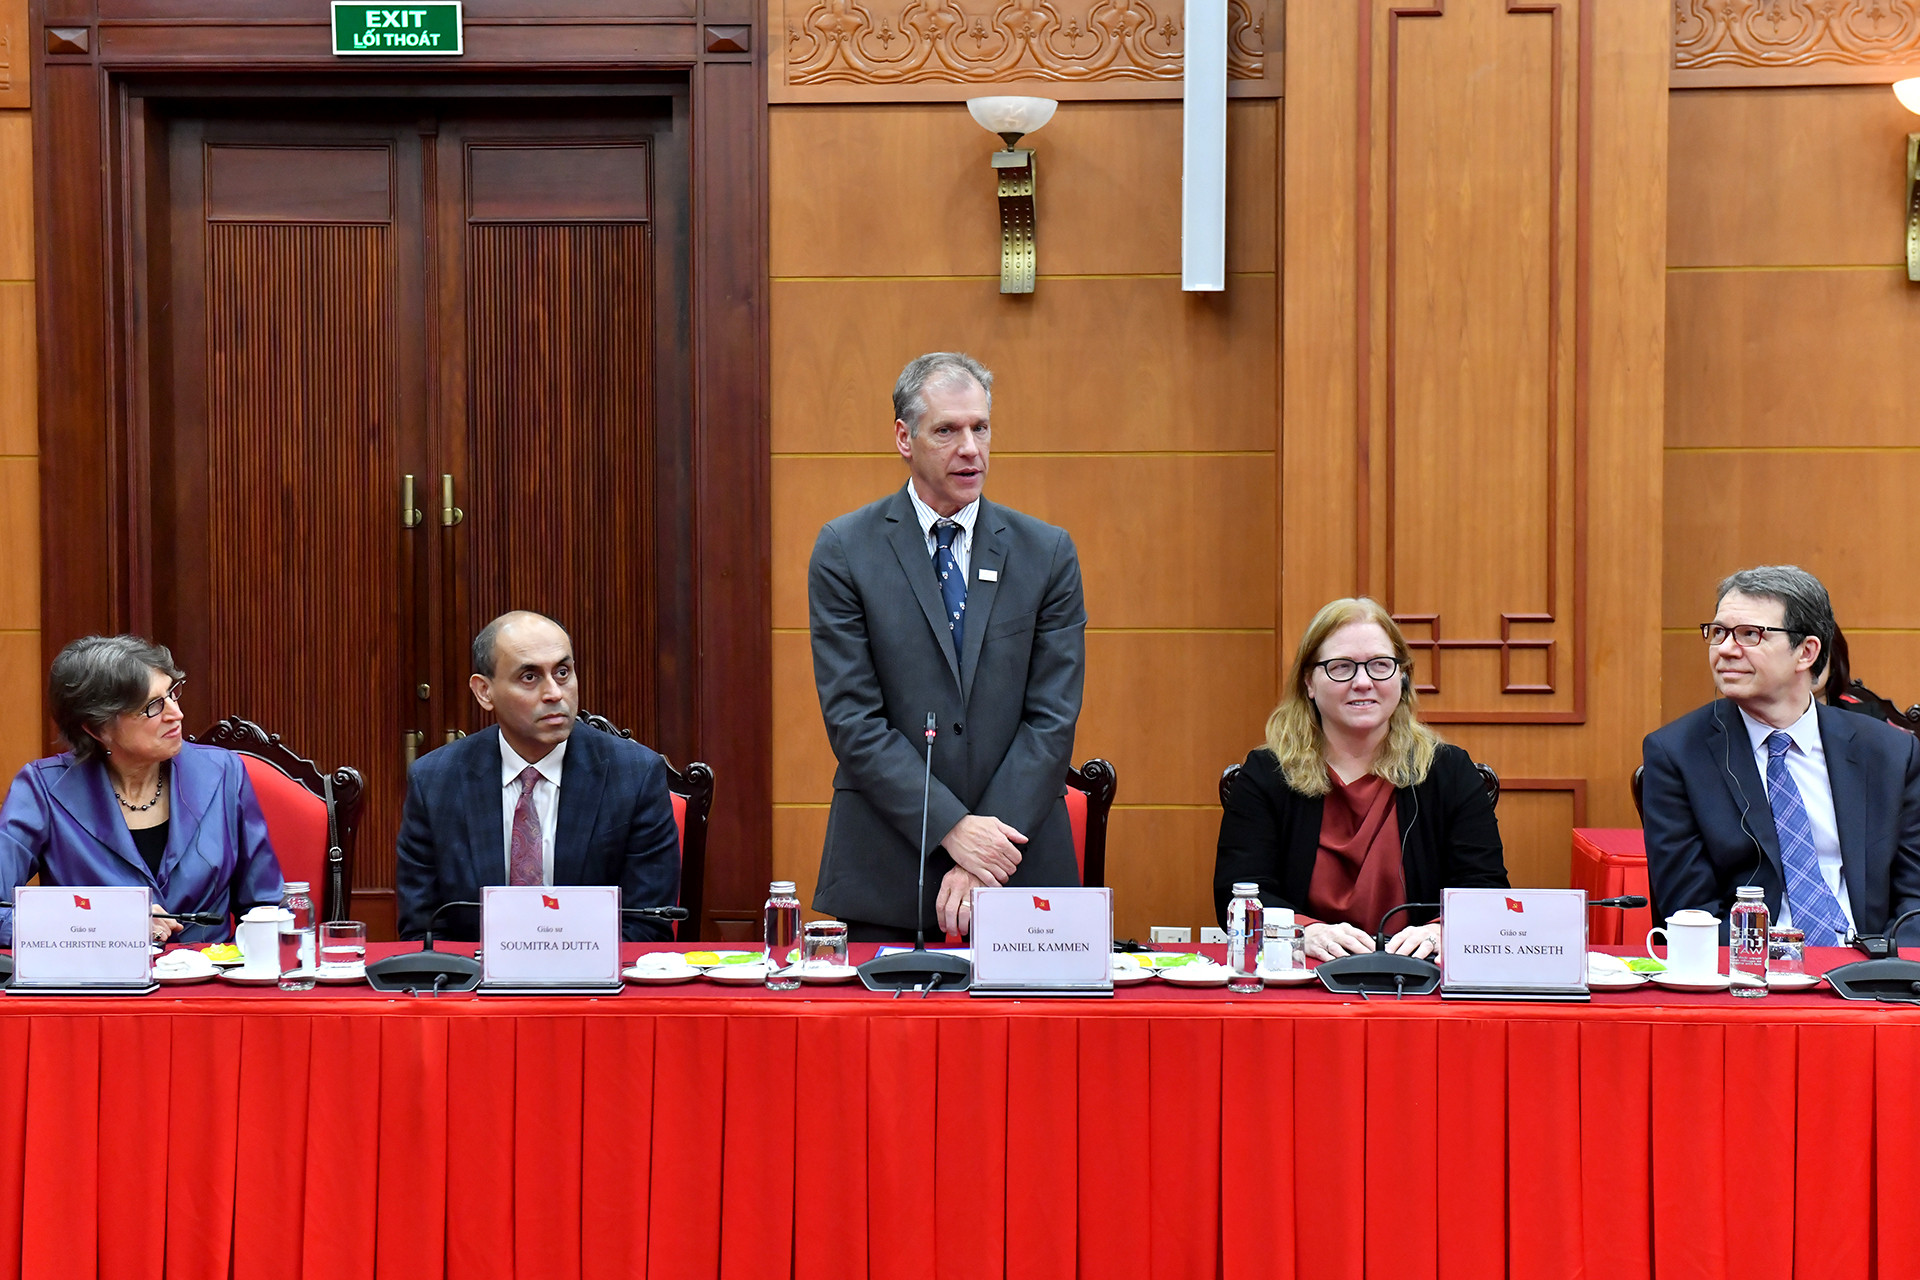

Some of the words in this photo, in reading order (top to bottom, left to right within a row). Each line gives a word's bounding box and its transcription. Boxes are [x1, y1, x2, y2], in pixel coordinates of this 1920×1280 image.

[366, 10, 427, 28] EXIT
[353, 28, 381, 47] LỐI
[383, 30, 441, 46] THOÁT
[20, 940, 57, 949] PAMELA
[59, 940, 107, 949] CHRISTINE
[108, 940, 146, 949] RONALD
[500, 941, 559, 951] SOUMITRA
[562, 941, 600, 951] DUTTA
[992, 943, 1035, 952] DANIEL
[1038, 943, 1090, 952] KAMMEN
[1463, 944, 1501, 954] KRISTI
[1504, 945, 1514, 954] S.
[1517, 945, 1563, 955] ANSETH
